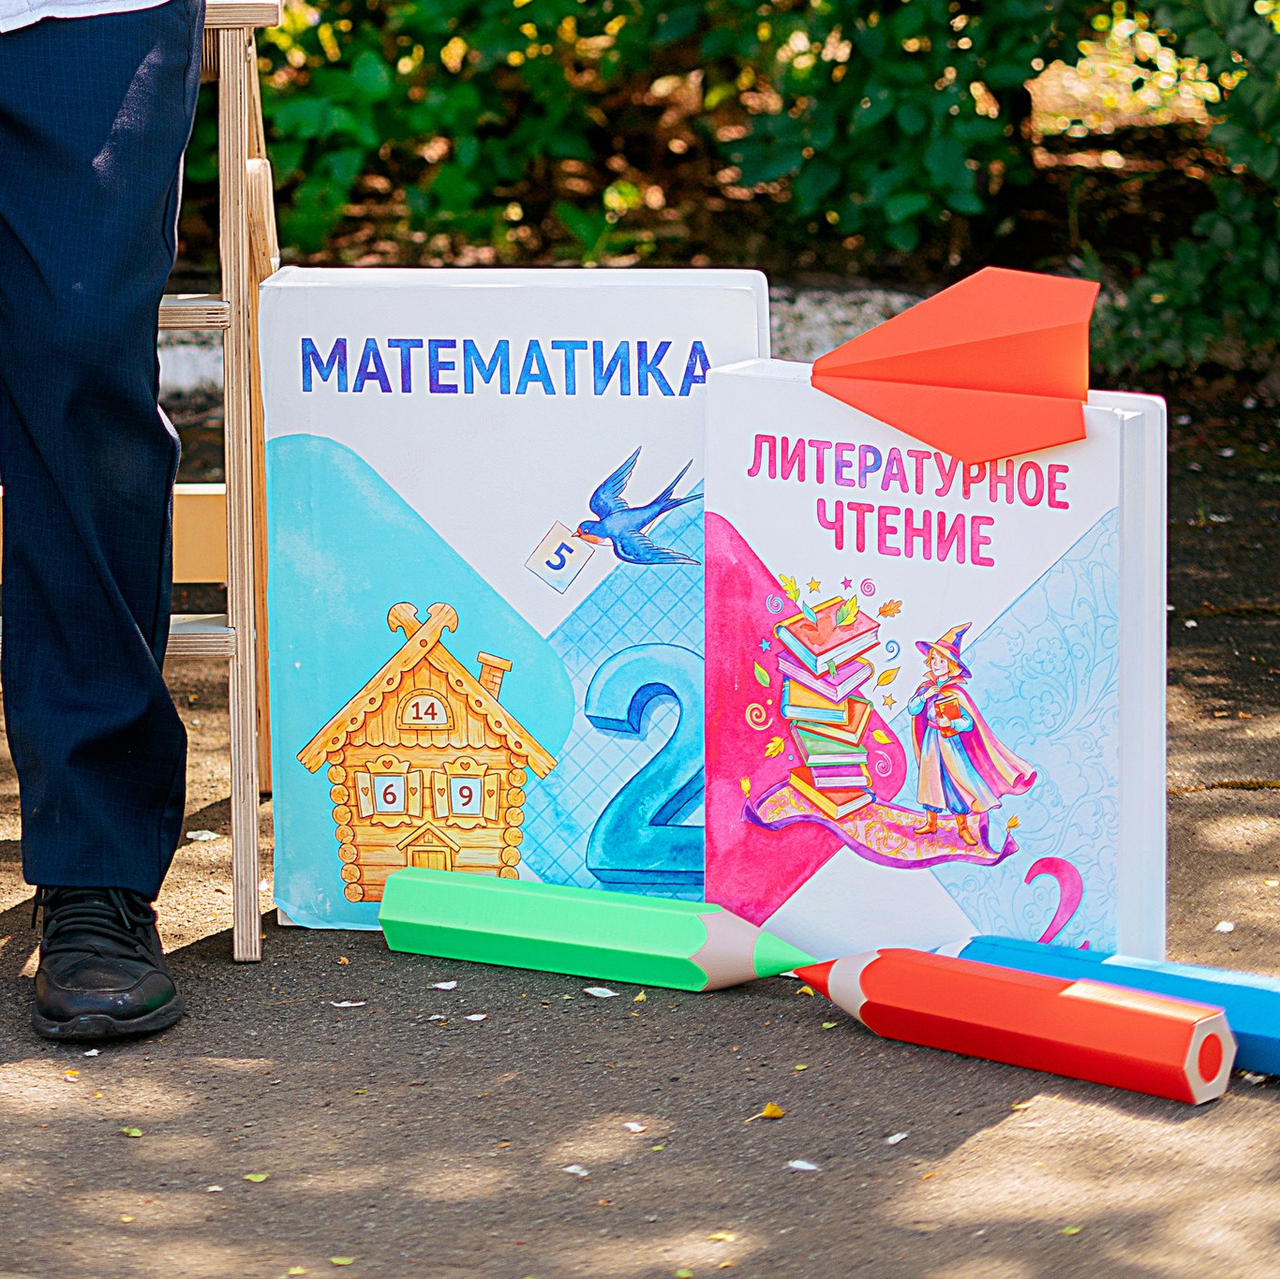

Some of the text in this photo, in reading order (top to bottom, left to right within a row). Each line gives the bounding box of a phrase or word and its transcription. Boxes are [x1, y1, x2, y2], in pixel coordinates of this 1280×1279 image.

[301, 337, 711, 397] МАТЕМАТИКА
[747, 434, 1069, 510] ЛИТЕРАТУРНОЕ
[817, 498, 995, 568] ЧТЕНИЕ
[545, 542, 574, 571] 5
[411, 702, 438, 721] 14
[584, 643, 704, 885] 2
[382, 783, 397, 805] 6
[458, 785, 473, 807] 9
